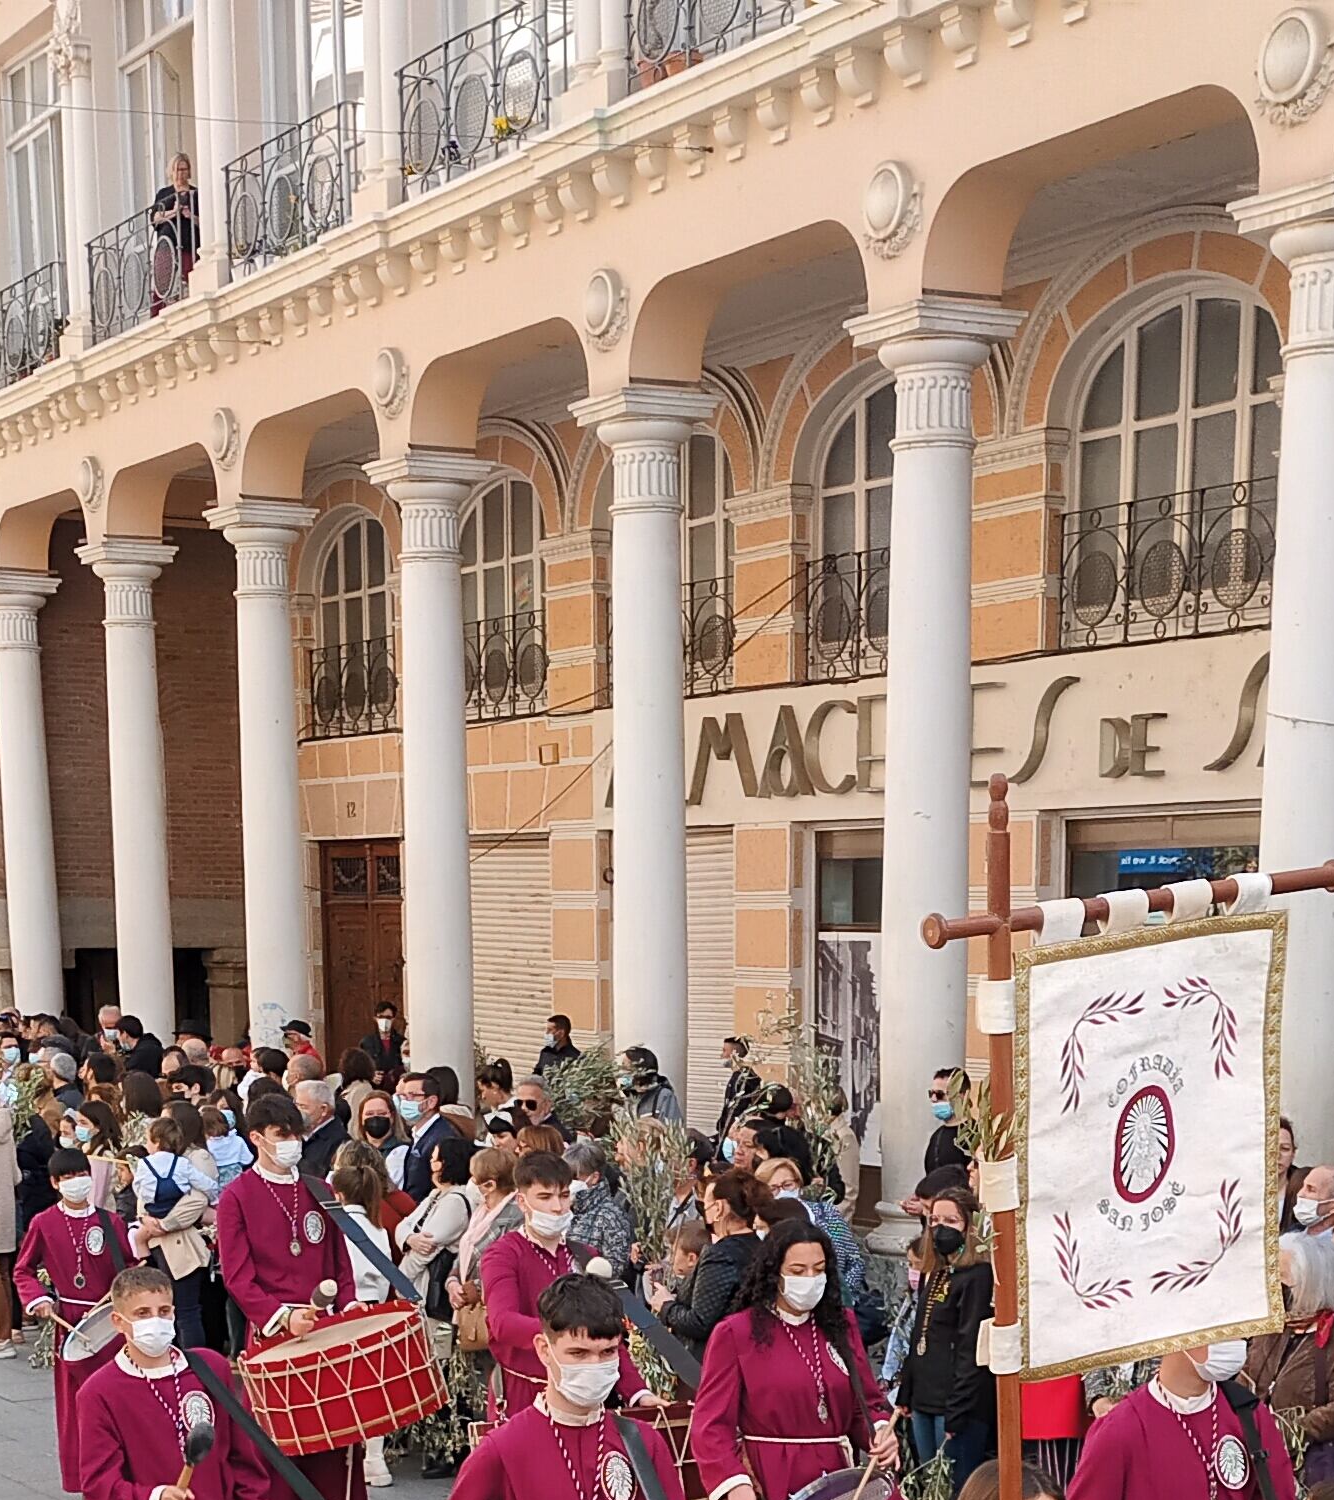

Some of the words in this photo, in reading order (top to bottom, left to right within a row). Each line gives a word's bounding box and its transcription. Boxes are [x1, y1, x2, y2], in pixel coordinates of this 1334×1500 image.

[1099, 712, 1168, 778] DE
[347, 801, 356, 818] 12
[1097, 1198, 1133, 1232] SAN
